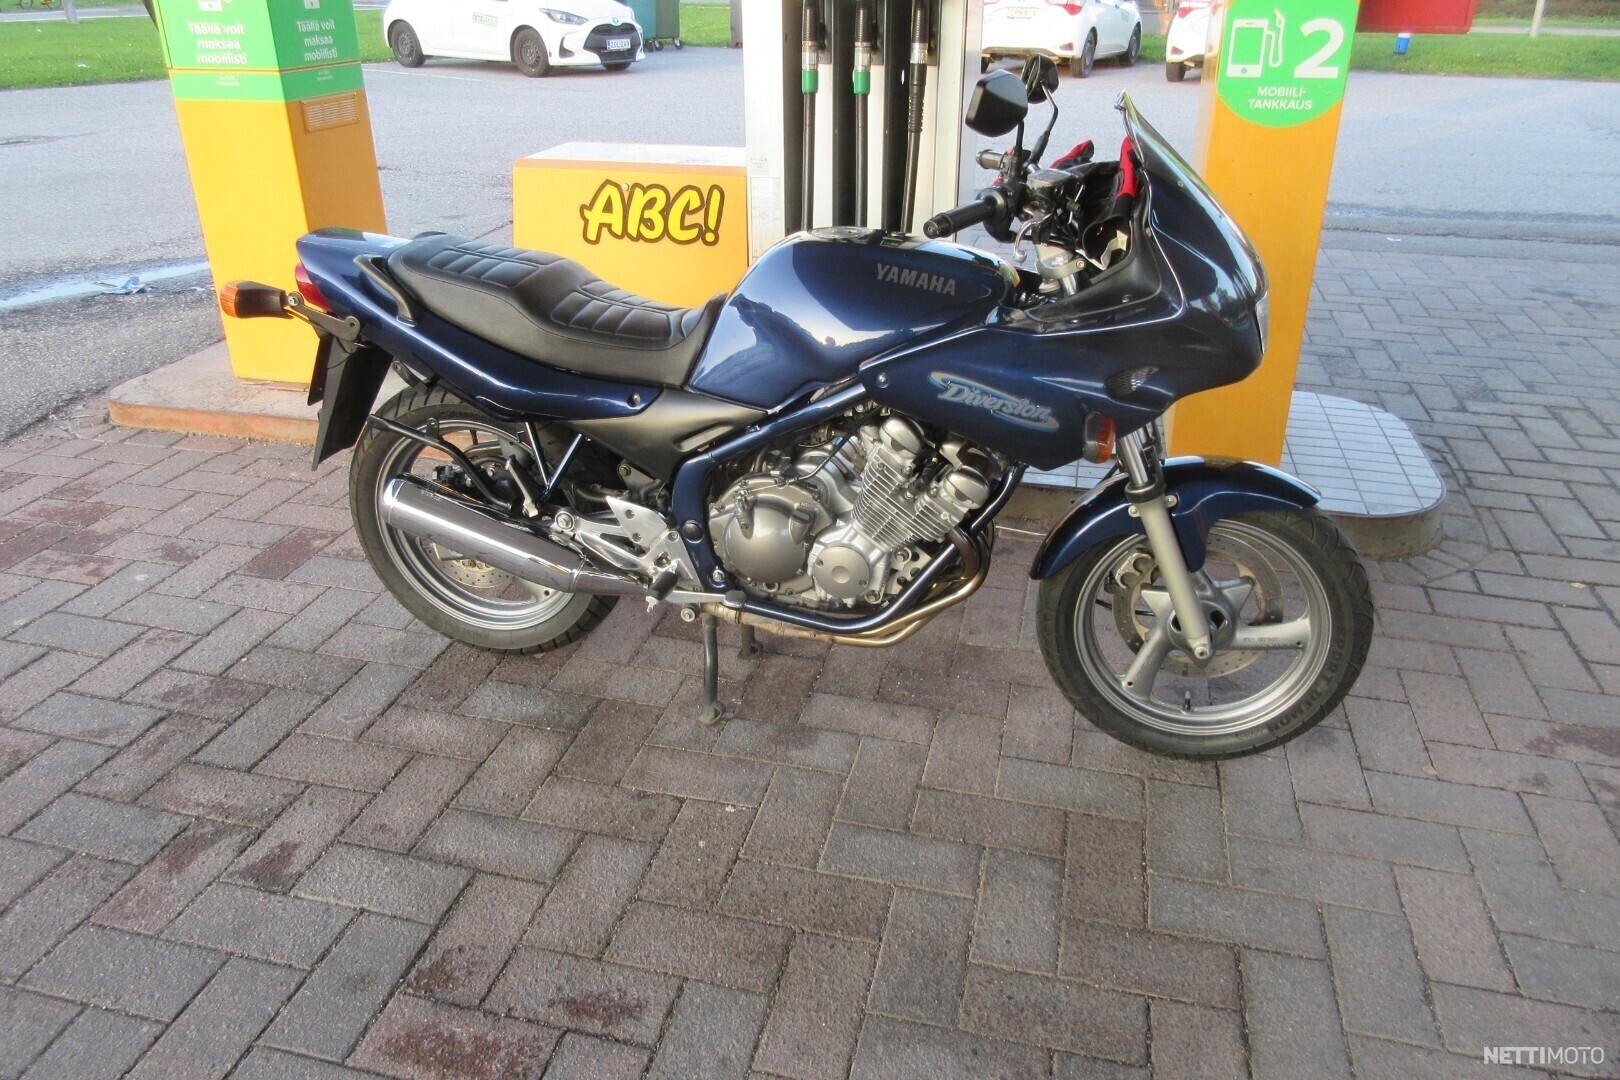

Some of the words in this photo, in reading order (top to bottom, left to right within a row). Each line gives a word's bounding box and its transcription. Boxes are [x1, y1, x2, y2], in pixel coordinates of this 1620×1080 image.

[188, 21, 221, 35] Täällä
[223, 22, 245, 35] voit
[296, 20, 320, 32] Täällä
[321, 18, 335, 30] voit
[197, 38, 241, 50] maksaa
[304, 34, 333, 47] maksaa
[304, 47, 338, 61] mobiilisti
[1293, 18, 1344, 79] 2
[197, 53, 248, 64] mobiilisti
[1257, 87, 1307, 97] MOBIILI-
[1248, 99, 1313, 110] TANKKAUS
[580, 179, 725, 246] ABC!
[876, 263, 957, 296] YAMAHA
[938, 380, 1052, 424] Diversion
